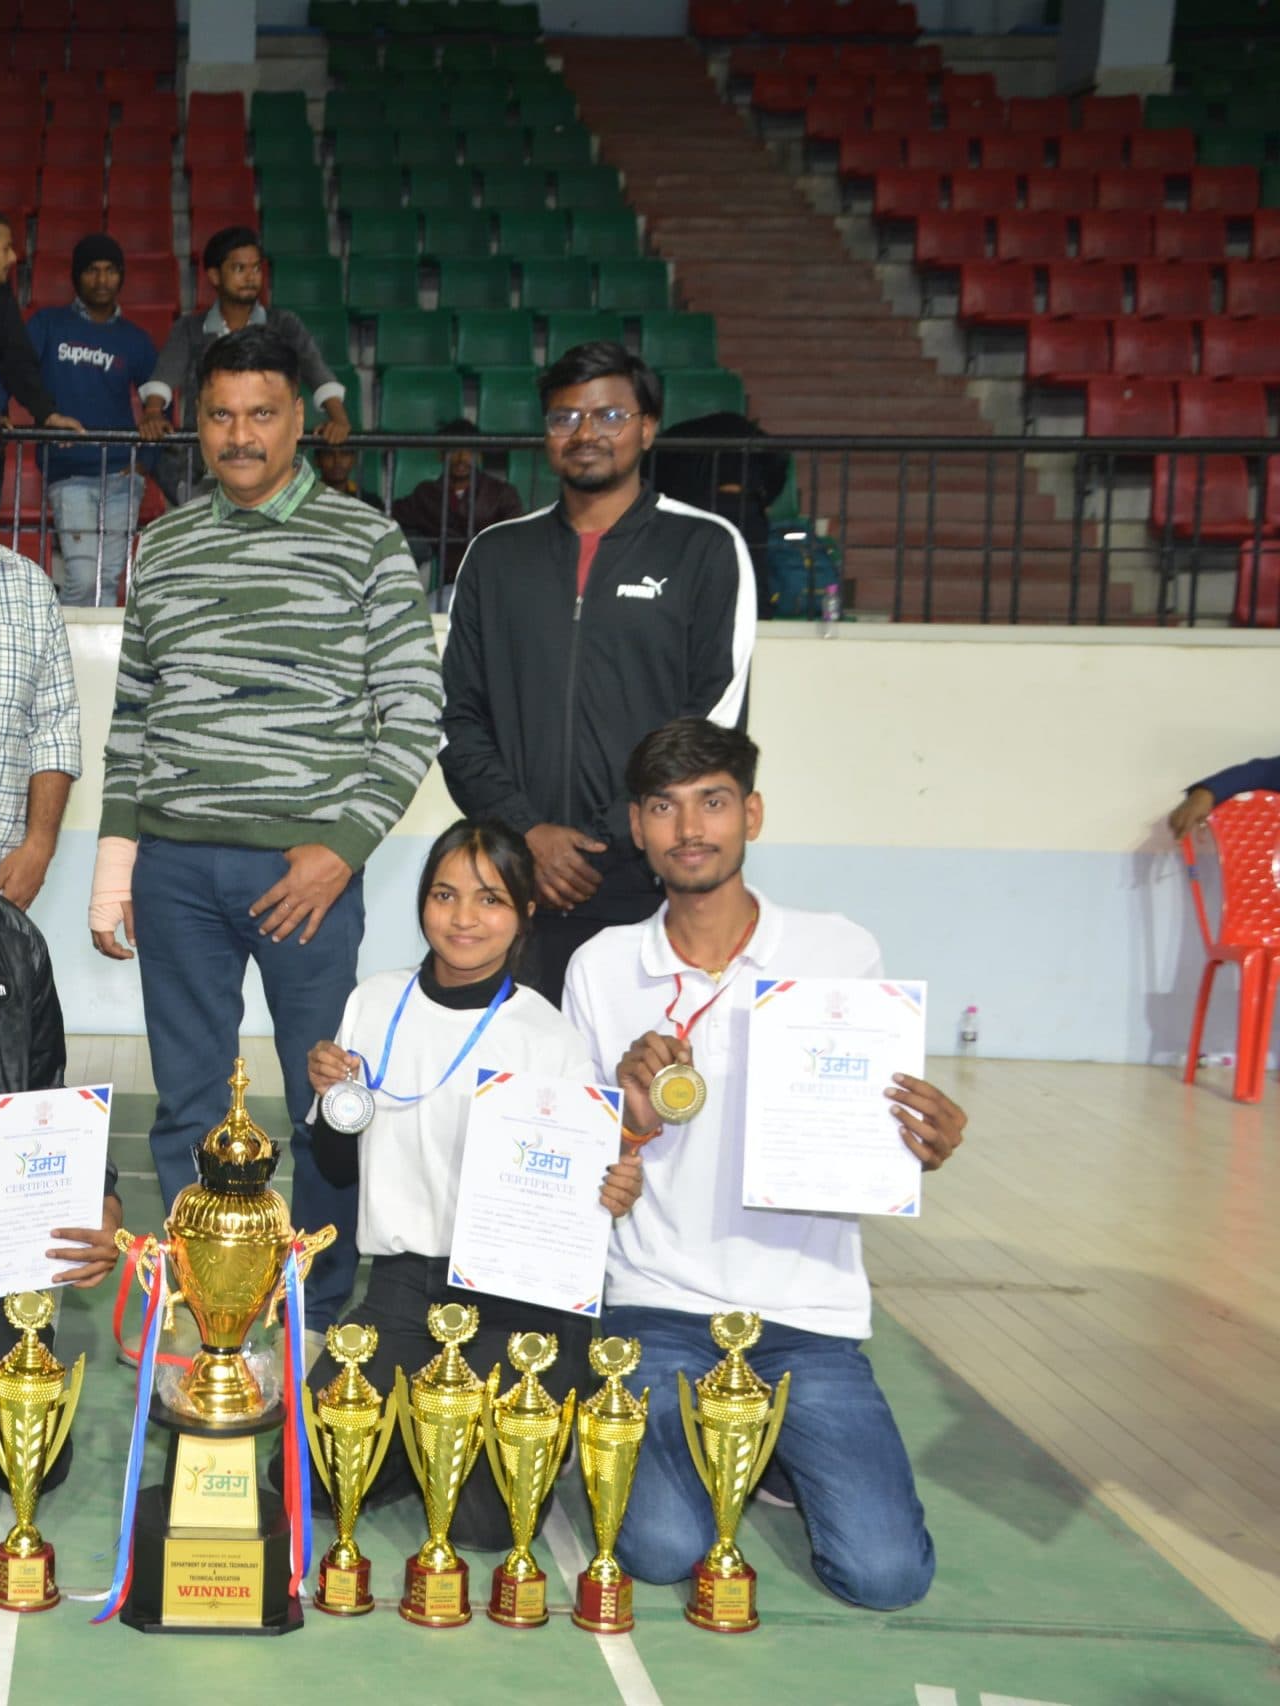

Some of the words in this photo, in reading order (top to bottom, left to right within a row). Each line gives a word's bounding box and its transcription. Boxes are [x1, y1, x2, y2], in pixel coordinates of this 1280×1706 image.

[58, 343, 114, 370] Superdry
[820, 1052, 869, 1080] उमंग
[28, 1152, 67, 1174] उमंग
[528, 1149, 571, 1179] उमंग
[5, 1177, 73, 1194] CERTIFICATE
[499, 1171, 575, 1195] CERTIFICATE
[202, 1469, 249, 1497] उमंग
[178, 1585, 251, 1598] WINNER
